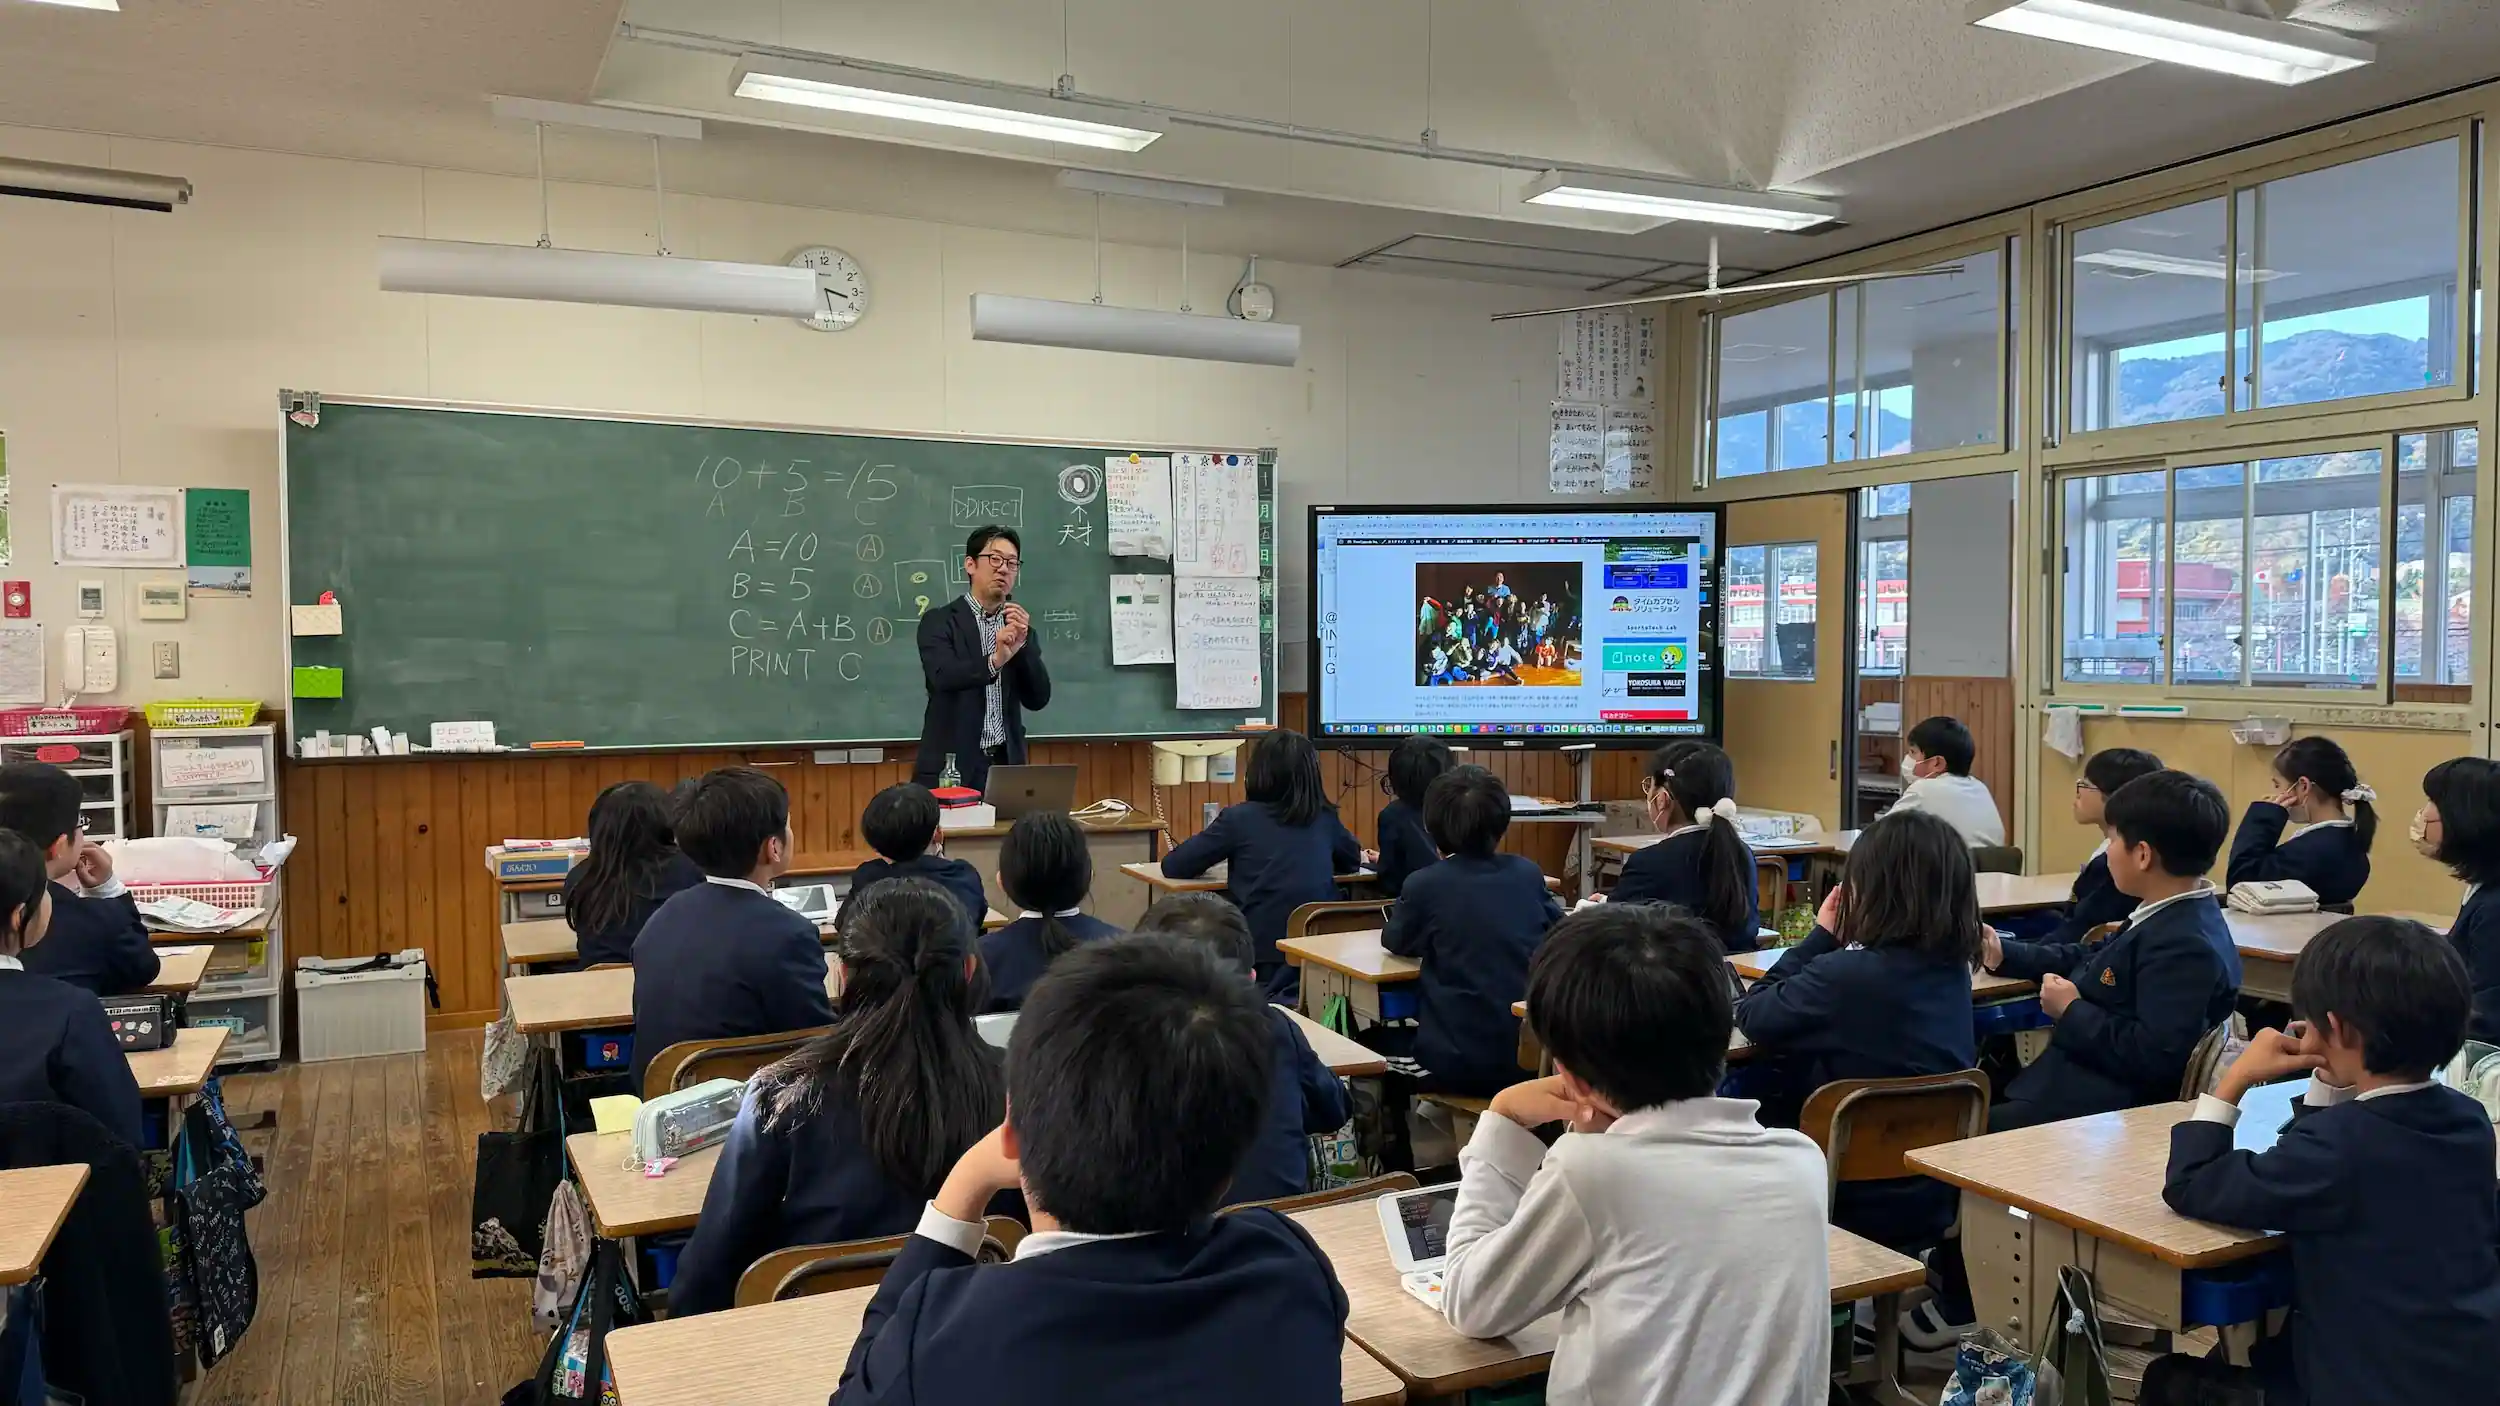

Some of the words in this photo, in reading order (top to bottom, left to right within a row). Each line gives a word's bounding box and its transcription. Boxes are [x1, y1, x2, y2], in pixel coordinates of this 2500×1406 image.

[804, 259, 814, 269] 11
[820, 256, 830, 266] 12
[837, 262, 842, 271] 1
[846, 272, 854, 282] 2
[851, 287, 859, 297] 3
[847, 301, 854, 311] 4
[705, 491, 726, 517] A
[780, 491, 806, 518] B
[854, 501, 878, 526] C
[1057, 520, 1093, 547] 天才
[1634, 598, 1680, 606] タイムカプセル
[1634, 605, 1680, 613] ソリューション
[1325, 611, 1338, 624] @
[1325, 645, 1338, 658] T
[1625, 652, 1657, 663] note
[731, 645, 816, 681] PRINT
[838, 652, 863, 681] C
[1628, 679, 1662, 687] YOKOSUKA
[1662, 679, 1686, 687] VALLEY
